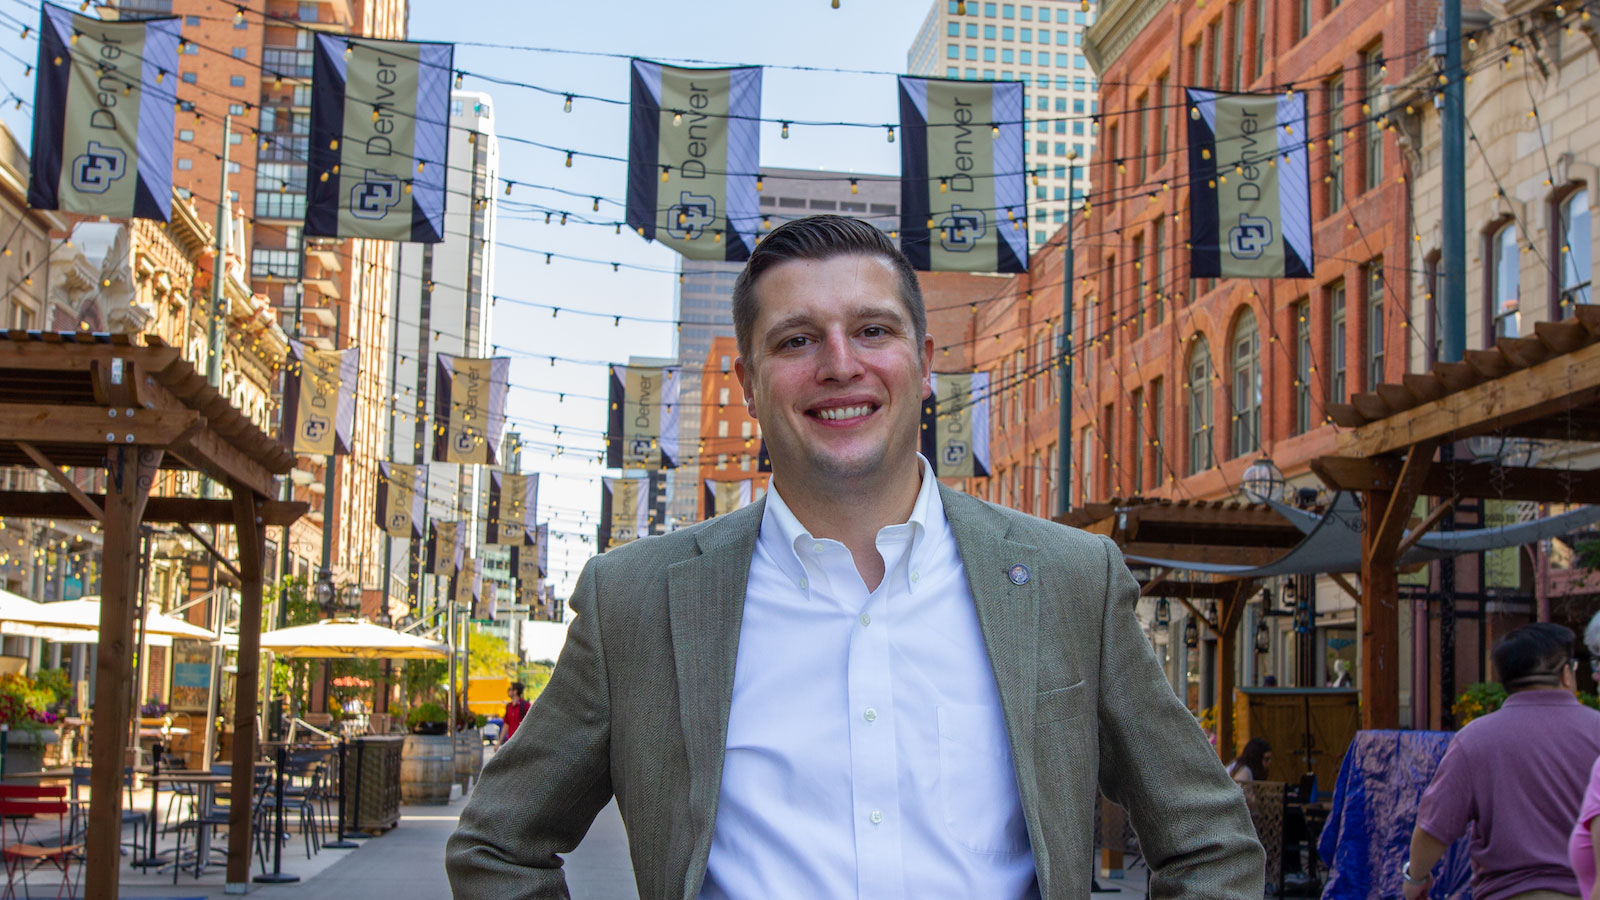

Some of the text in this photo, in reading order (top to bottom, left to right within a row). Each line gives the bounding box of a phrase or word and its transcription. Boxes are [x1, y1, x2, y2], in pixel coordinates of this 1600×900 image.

[90, 33, 122, 130] Denver
[366, 57, 397, 156] Denver
[681, 82, 708, 179] Denver
[950, 97, 974, 192] Denver
[1238, 108, 1260, 201] Denver
[635, 375, 652, 428] Denver
